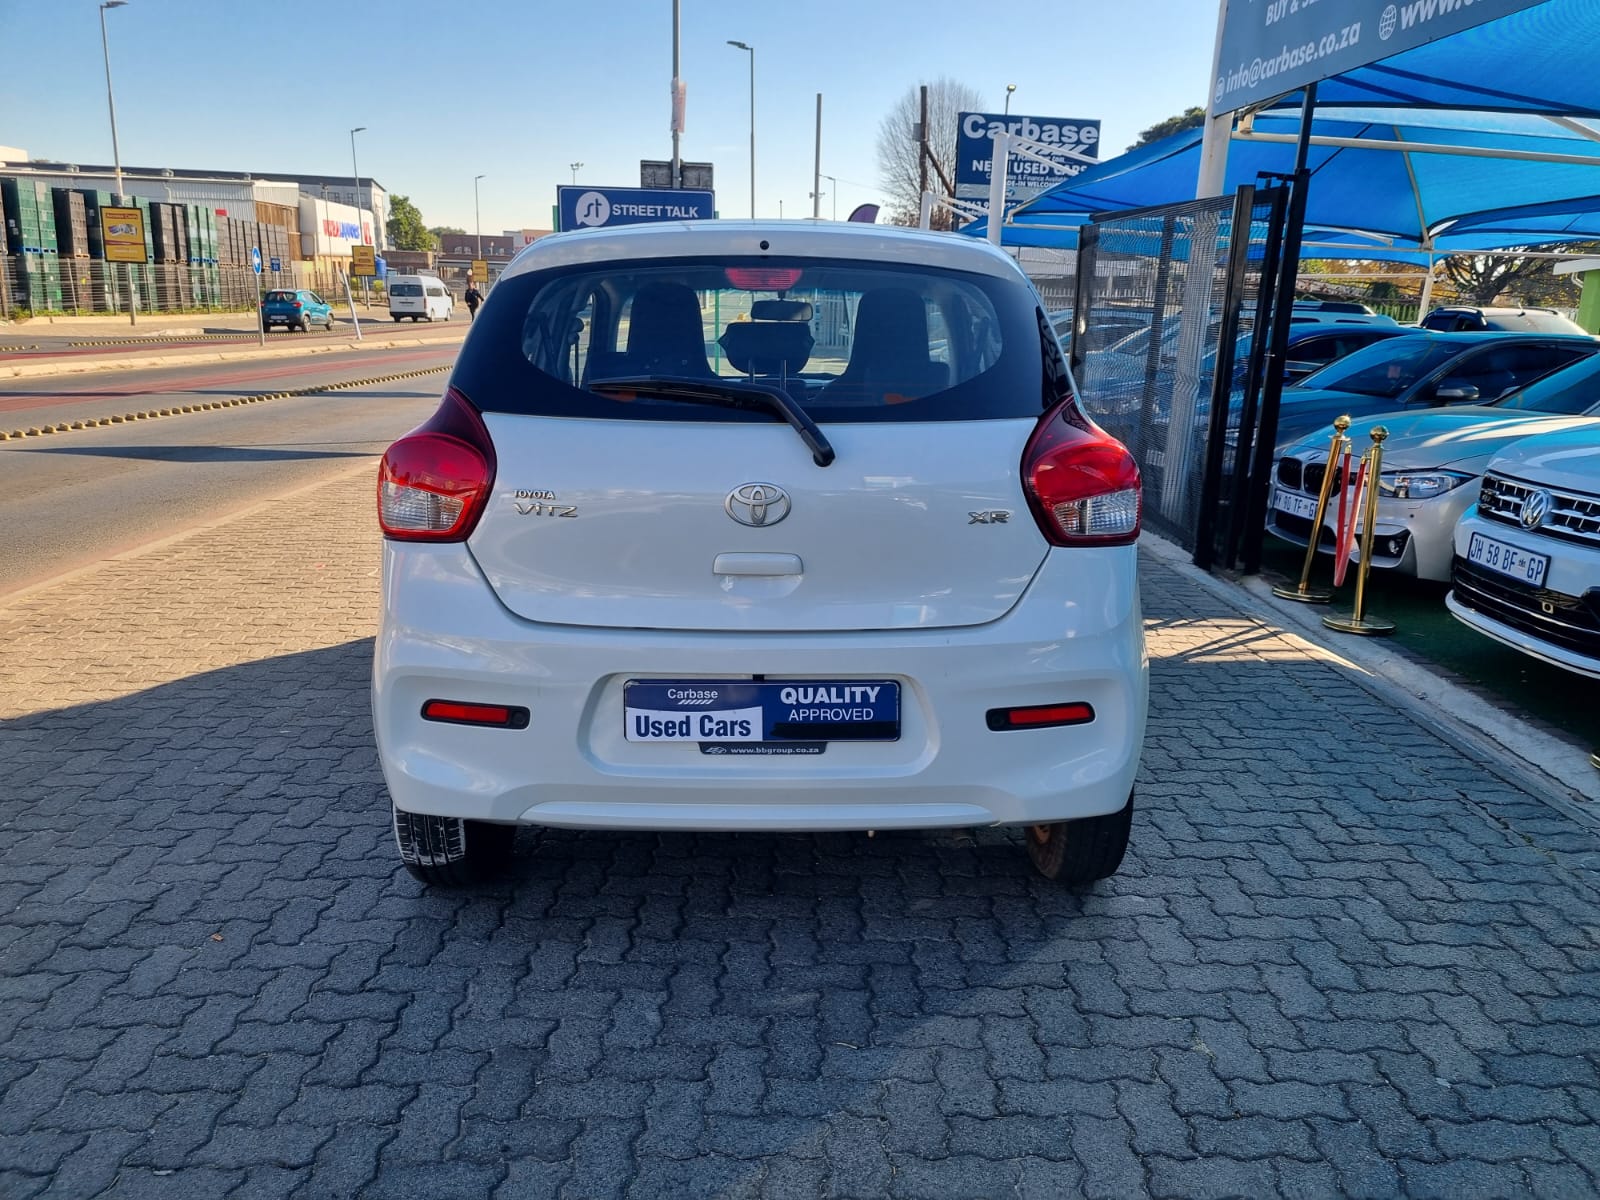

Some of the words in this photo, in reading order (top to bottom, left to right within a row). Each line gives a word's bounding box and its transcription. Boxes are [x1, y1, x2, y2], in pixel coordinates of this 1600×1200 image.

[1265, 0, 1288, 26] BUY
[1225, 22, 1361, 93] info@carbase.co.za
[963, 114, 1099, 144] Carbase
[972, 160, 992, 172] NE
[1013, 162, 1050, 175] USED
[612, 203, 664, 217] STREET
[665, 205, 699, 218] TALK
[513, 489, 555, 500] TOYOTA
[967, 510, 1010, 525] XR
[1470, 538, 1484, 561] JH
[1486, 543, 1500, 567] 58
[1502, 549, 1518, 572] BF
[1527, 557, 1544, 581] GP
[667, 687, 719, 699] Carbase
[780, 686, 881, 705] QUALITY
[788, 708, 874, 721] APPROVED
[635, 714, 691, 737] Used
[699, 714, 751, 737] Cars
[730, 746, 820, 755] www.bbgroup.co.za
